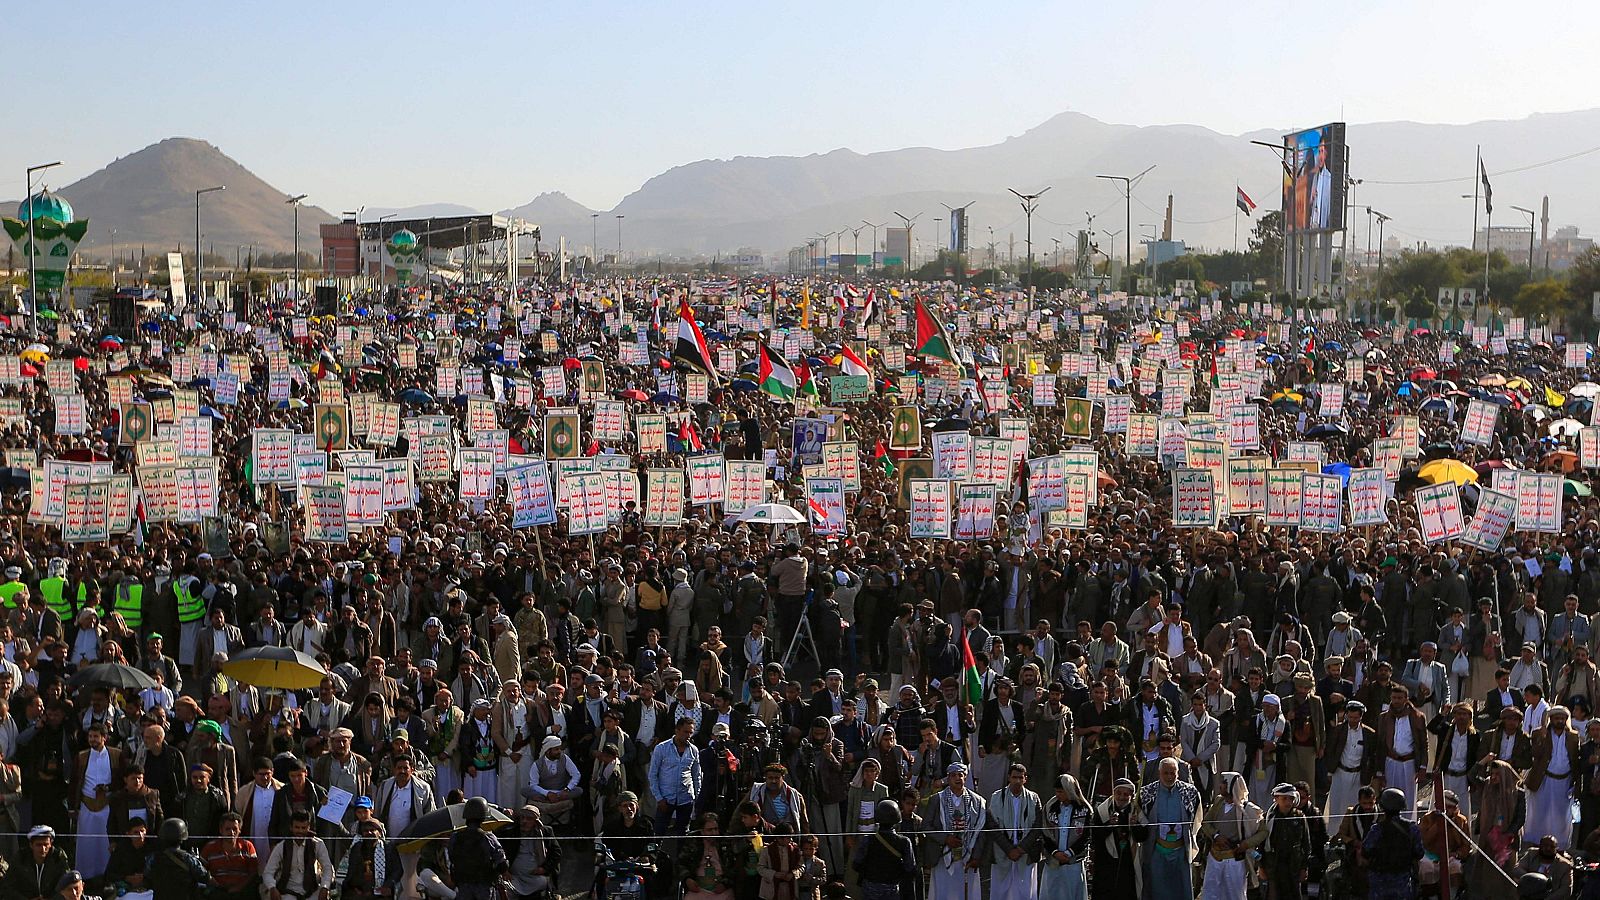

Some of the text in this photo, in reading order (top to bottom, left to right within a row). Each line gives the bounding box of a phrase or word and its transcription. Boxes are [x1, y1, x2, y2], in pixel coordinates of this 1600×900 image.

[463, 453, 491, 464] قاطعوا
[692, 457, 721, 470] قاطعوا
[1231, 463, 1264, 475] قاطعوا
[349, 471, 381, 483] قاطعوا
[1269, 473, 1300, 484] قاطعوا
[963, 487, 992, 501] قاطعوا
[1421, 485, 1454, 504] قاطعوا
